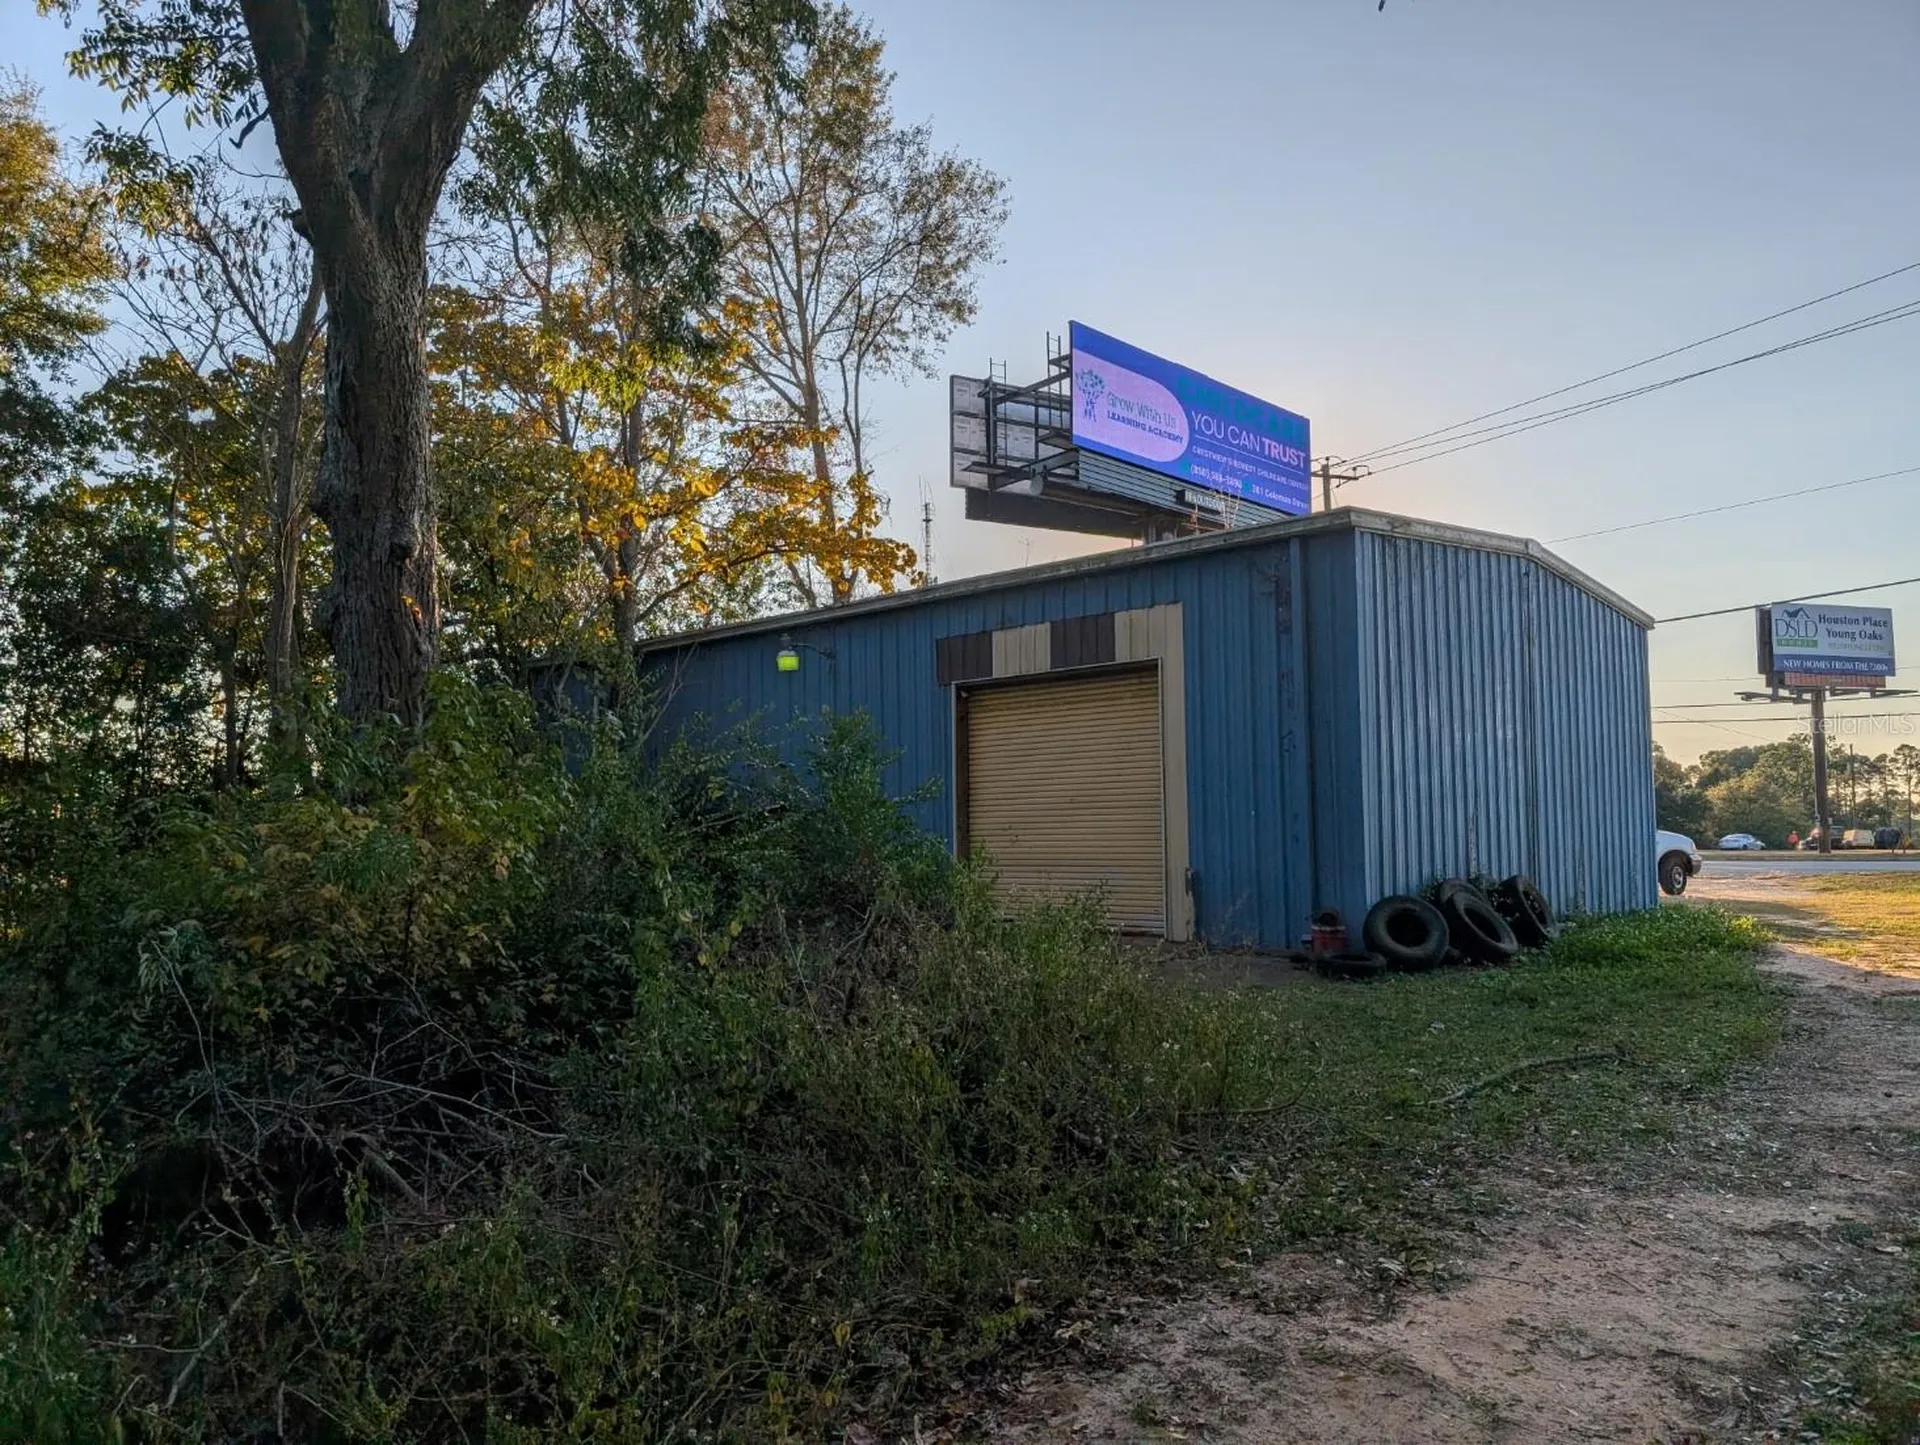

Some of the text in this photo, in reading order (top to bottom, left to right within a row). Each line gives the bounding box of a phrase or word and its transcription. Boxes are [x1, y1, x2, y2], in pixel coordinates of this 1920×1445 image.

[1106, 391, 1177, 428] Grow With Us
[1148, 424, 1184, 445] ACADEMY
[1191, 411, 1306, 468] YOU CAN TRUST
[1775, 618, 1819, 638] DSLD
[1818, 613, 1888, 628] Houston Place
[1825, 628, 1883, 641] Young Oaks
[1783, 659, 1801, 670] NEW
[1802, 660, 1831, 670] HOMES
[1832, 660, 1853, 671] FROM
[1853, 661, 1869, 671] THE
